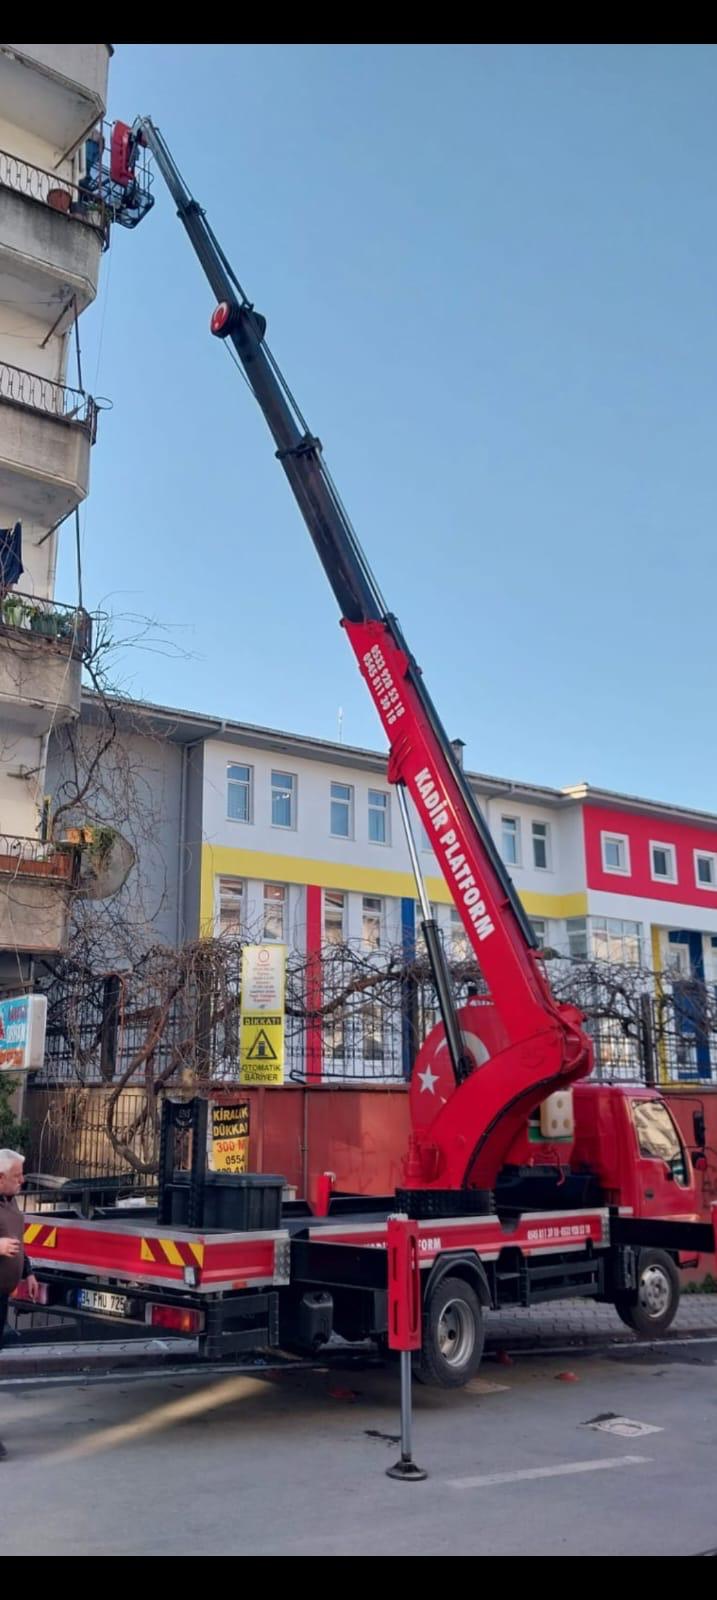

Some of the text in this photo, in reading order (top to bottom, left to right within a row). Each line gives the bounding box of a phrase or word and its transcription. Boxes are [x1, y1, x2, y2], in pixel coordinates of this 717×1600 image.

[386, 709, 397, 725] 18
[394, 701, 406, 717] 18
[414, 767, 496, 942] KADİR PLATFORM
[216, 1141, 235, 1153] 300
